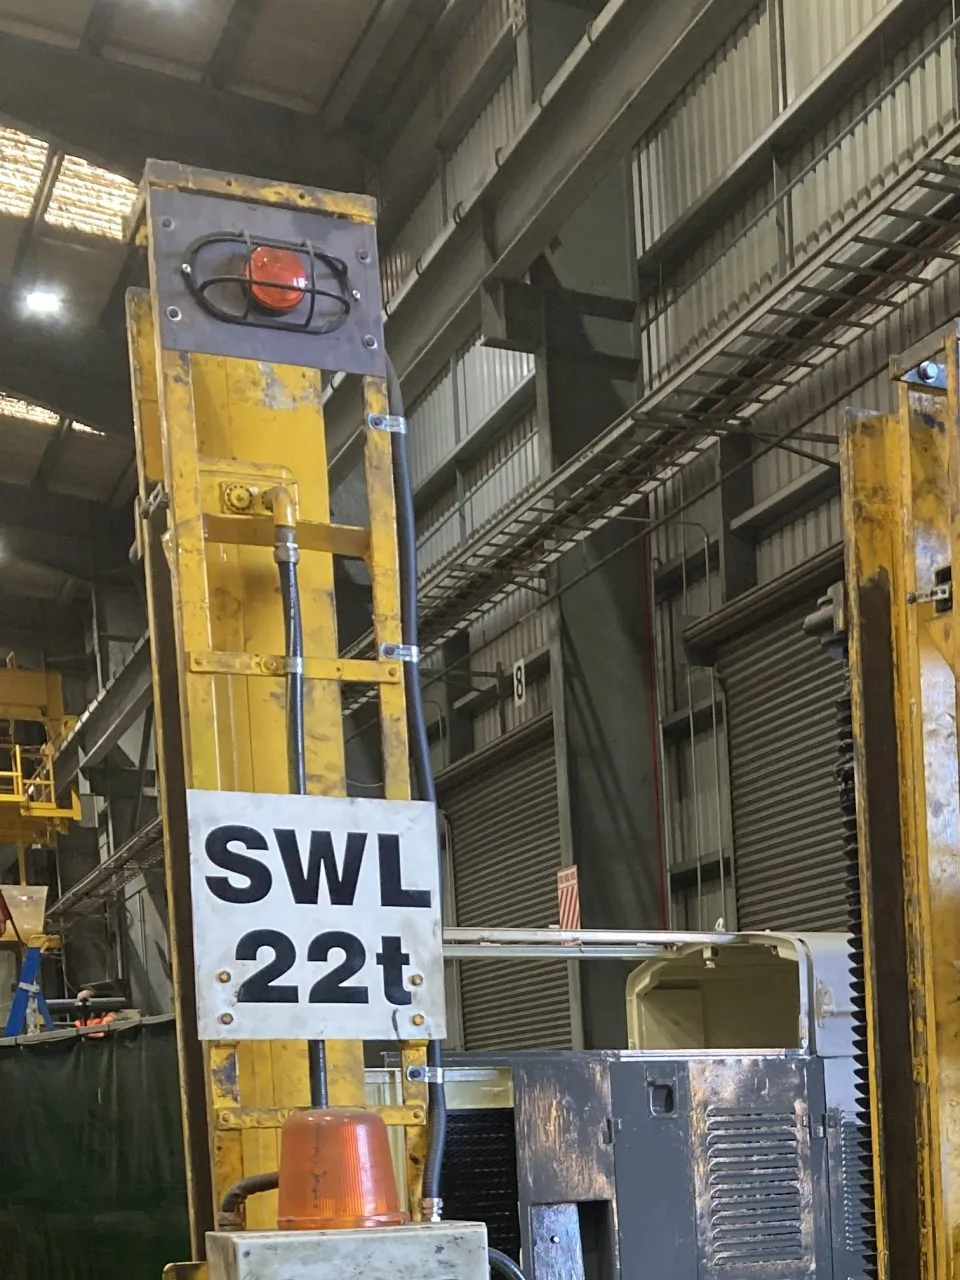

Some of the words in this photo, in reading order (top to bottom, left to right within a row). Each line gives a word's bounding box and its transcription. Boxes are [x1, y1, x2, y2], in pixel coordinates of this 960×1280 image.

[515, 665, 523, 700] 8
[204, 824, 432, 908] SWL
[235, 928, 413, 1006] 22t
